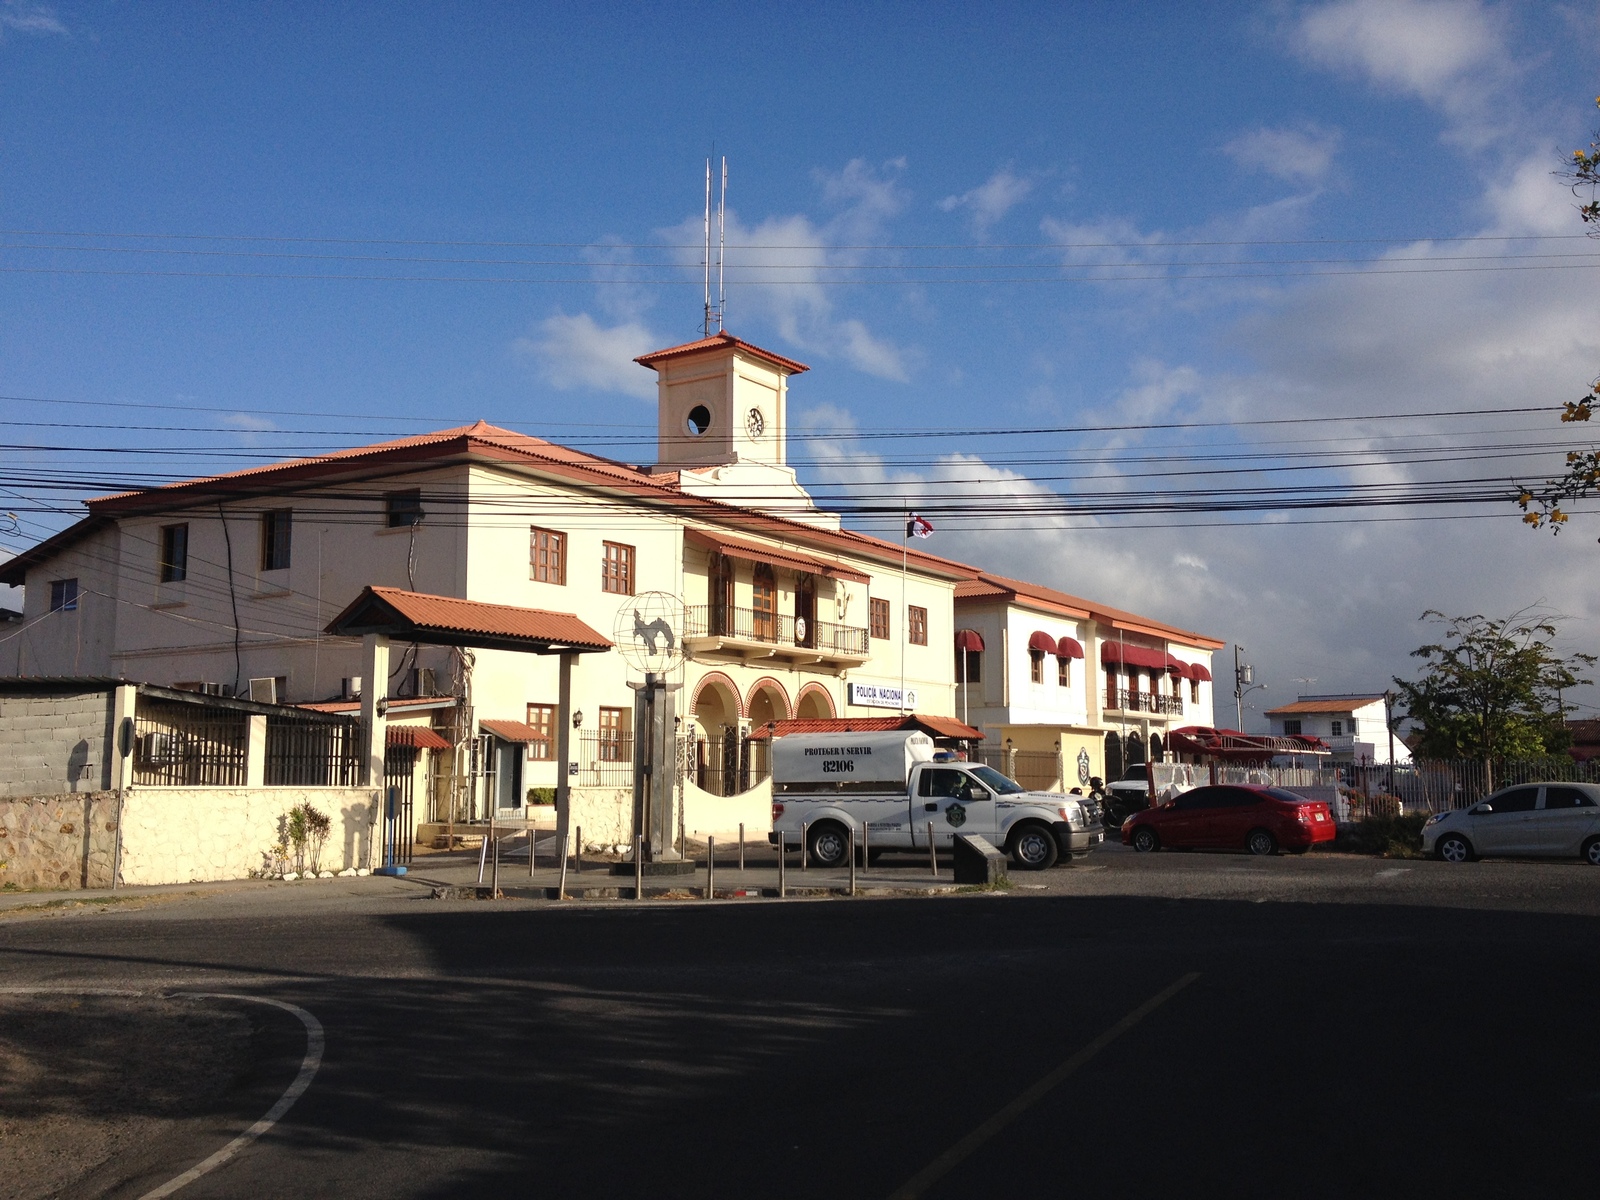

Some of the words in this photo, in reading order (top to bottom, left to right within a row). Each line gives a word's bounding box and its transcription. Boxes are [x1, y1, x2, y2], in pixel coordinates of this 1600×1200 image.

[879, 688, 903, 700] NACIONA
[804, 747, 840, 756] PROTEGER
[841, 747, 846, 755] Y
[847, 746, 872, 755] SERVIR
[822, 760, 854, 773] 82106
